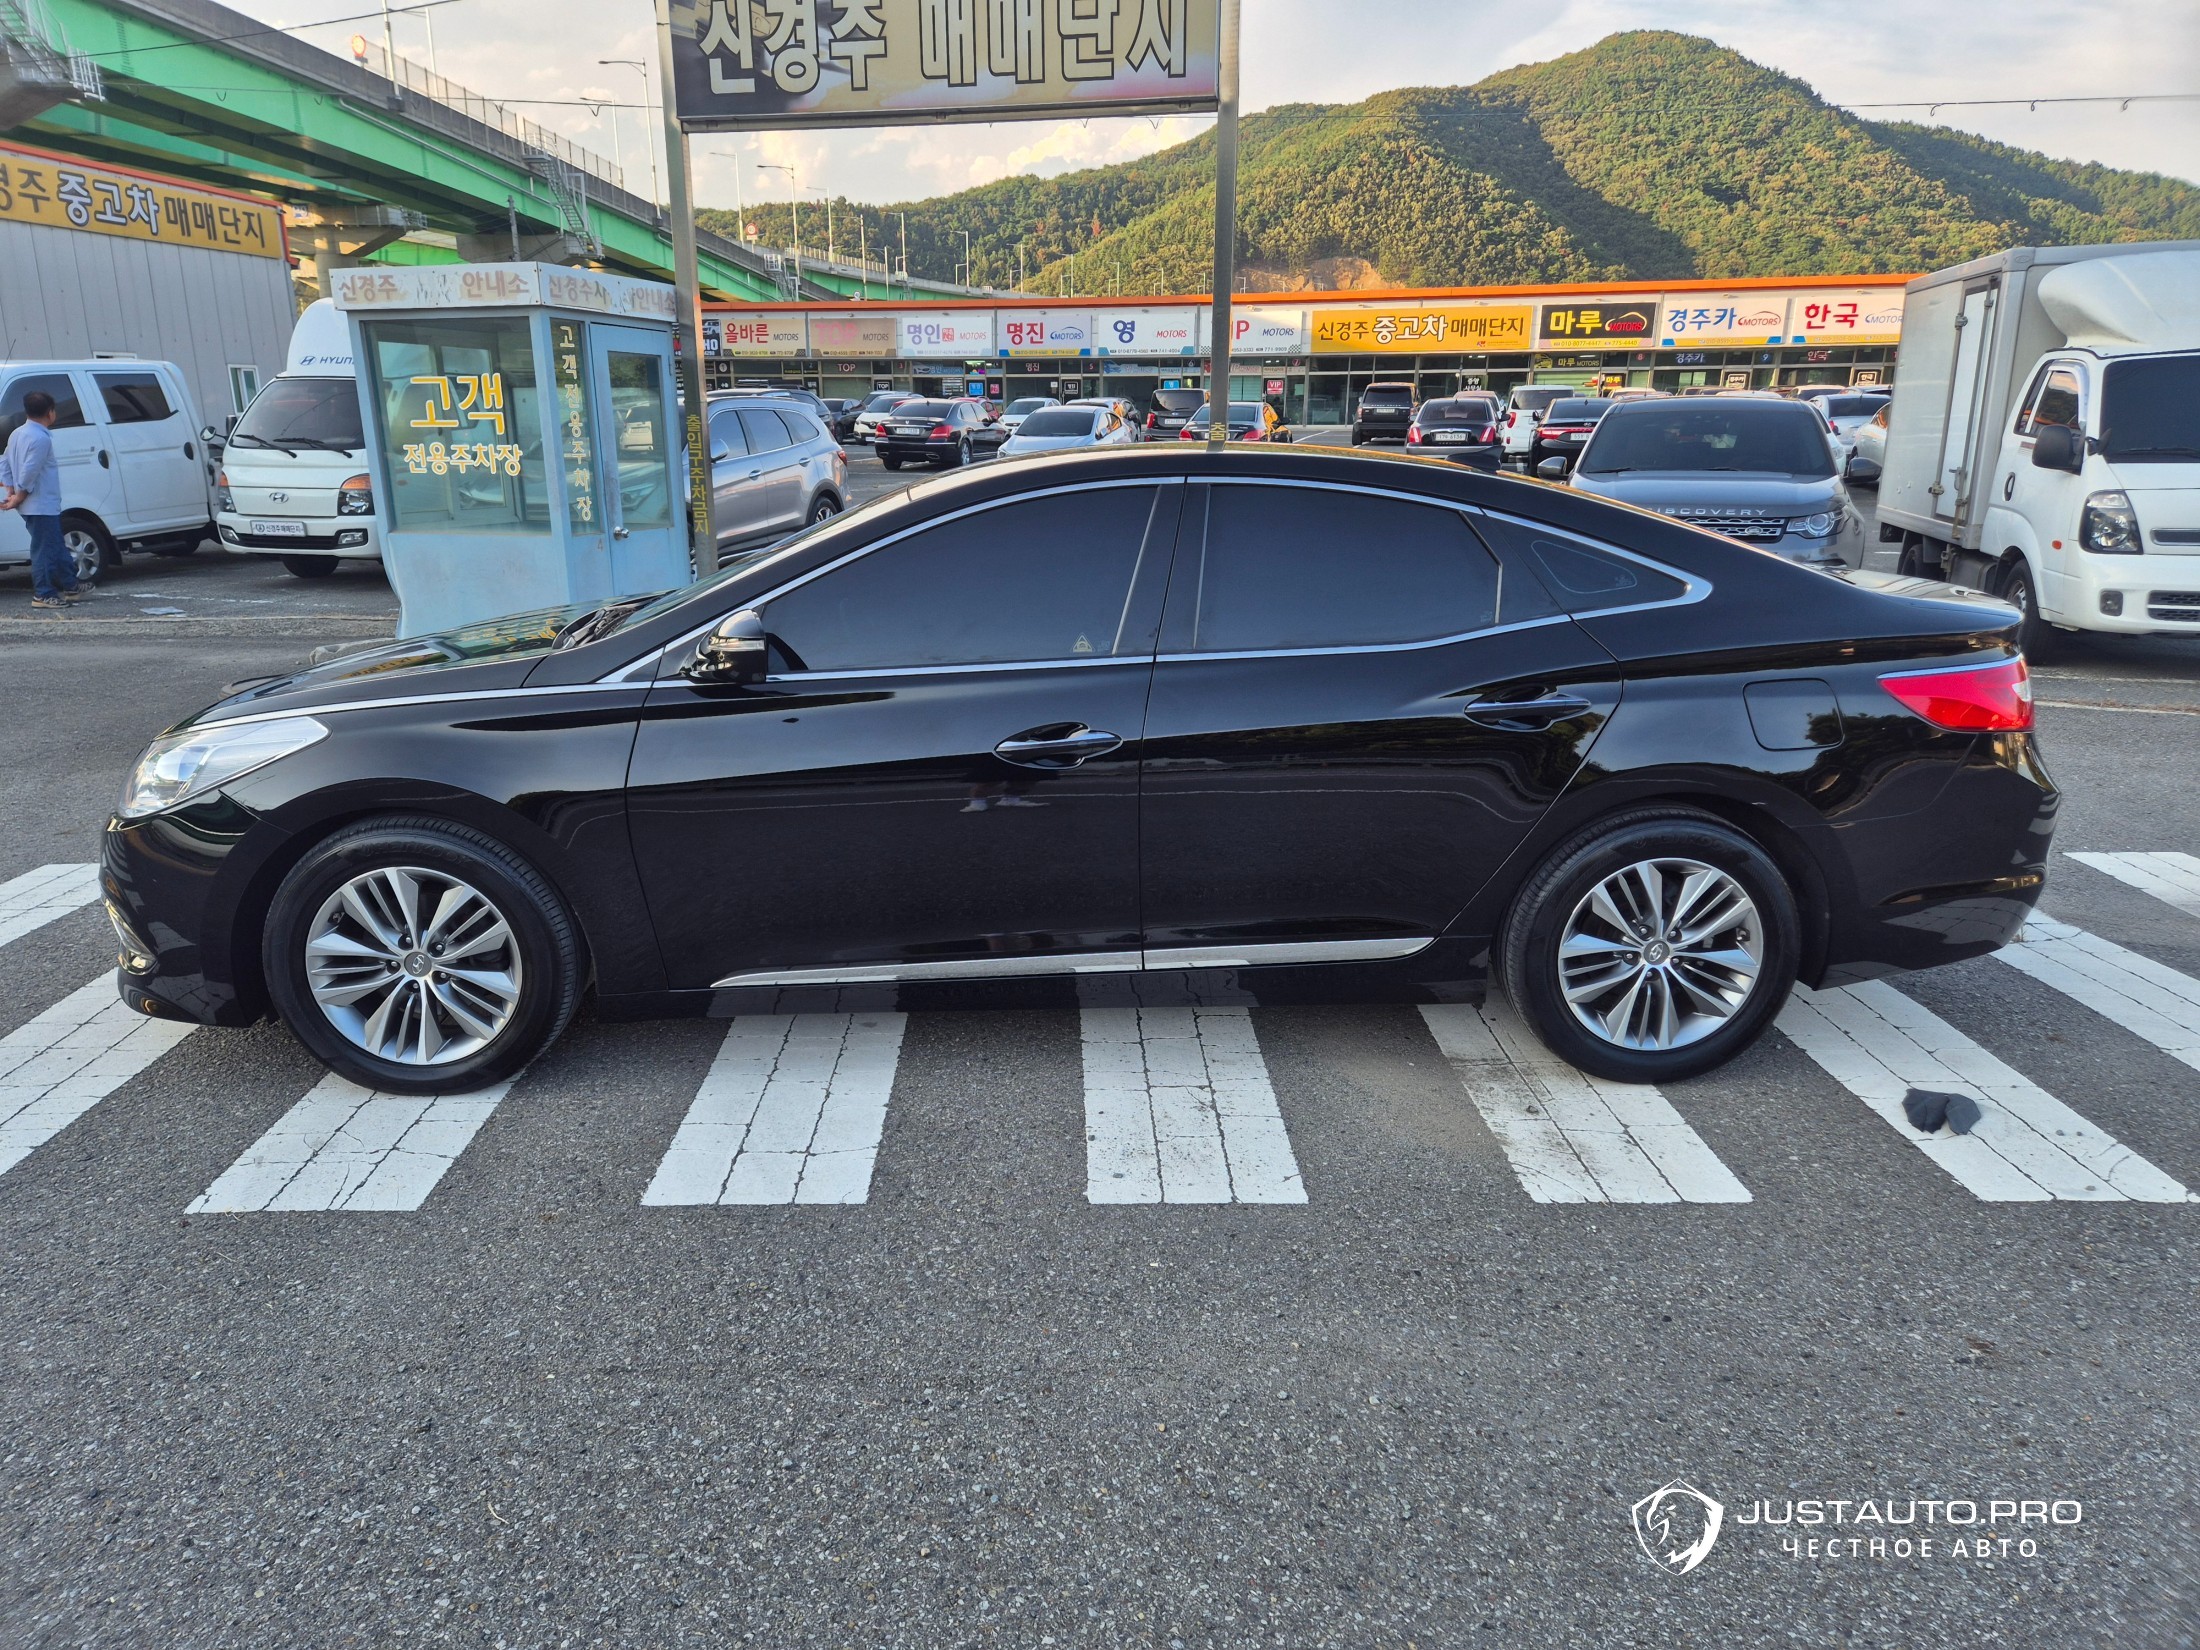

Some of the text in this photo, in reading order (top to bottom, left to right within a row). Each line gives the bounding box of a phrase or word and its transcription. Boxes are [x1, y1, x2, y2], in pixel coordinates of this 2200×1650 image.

[56, 170, 160, 236] 중고차
[164, 196, 266, 248] 매매단지
[1549, 310, 1643, 334] 마루 MOTORS
[1667, 307, 1778, 332] 경주카 MOTORS
[1805, 303, 1904, 329] 한국 MOTOR
[724, 322, 799, 344] 올바른 MOTORS
[815, 321, 889, 346] TOP MOTORS
[907, 324, 940, 345] 명인
[960, 331, 987, 340] MOTORS
[1006, 322, 1082, 345] 명진 MOTORS
[1113, 320, 1187, 343] 영 MOTORS
[1262, 327, 1294, 336] MOTORS
[1318, 314, 1524, 344] 신경주 중고차 매매단지
[319, 356, 355, 365] HYUN
[837, 363, 856, 372] TOP
[1026, 362, 1040, 372] 명진
[1558, 357, 1575, 366] 마루
[1676, 353, 1705, 363] 경주카
[409, 372, 505, 436] 고객
[402, 441, 523, 477] 전용주차장
[1647, 507, 1767, 516] ISCOVERY
